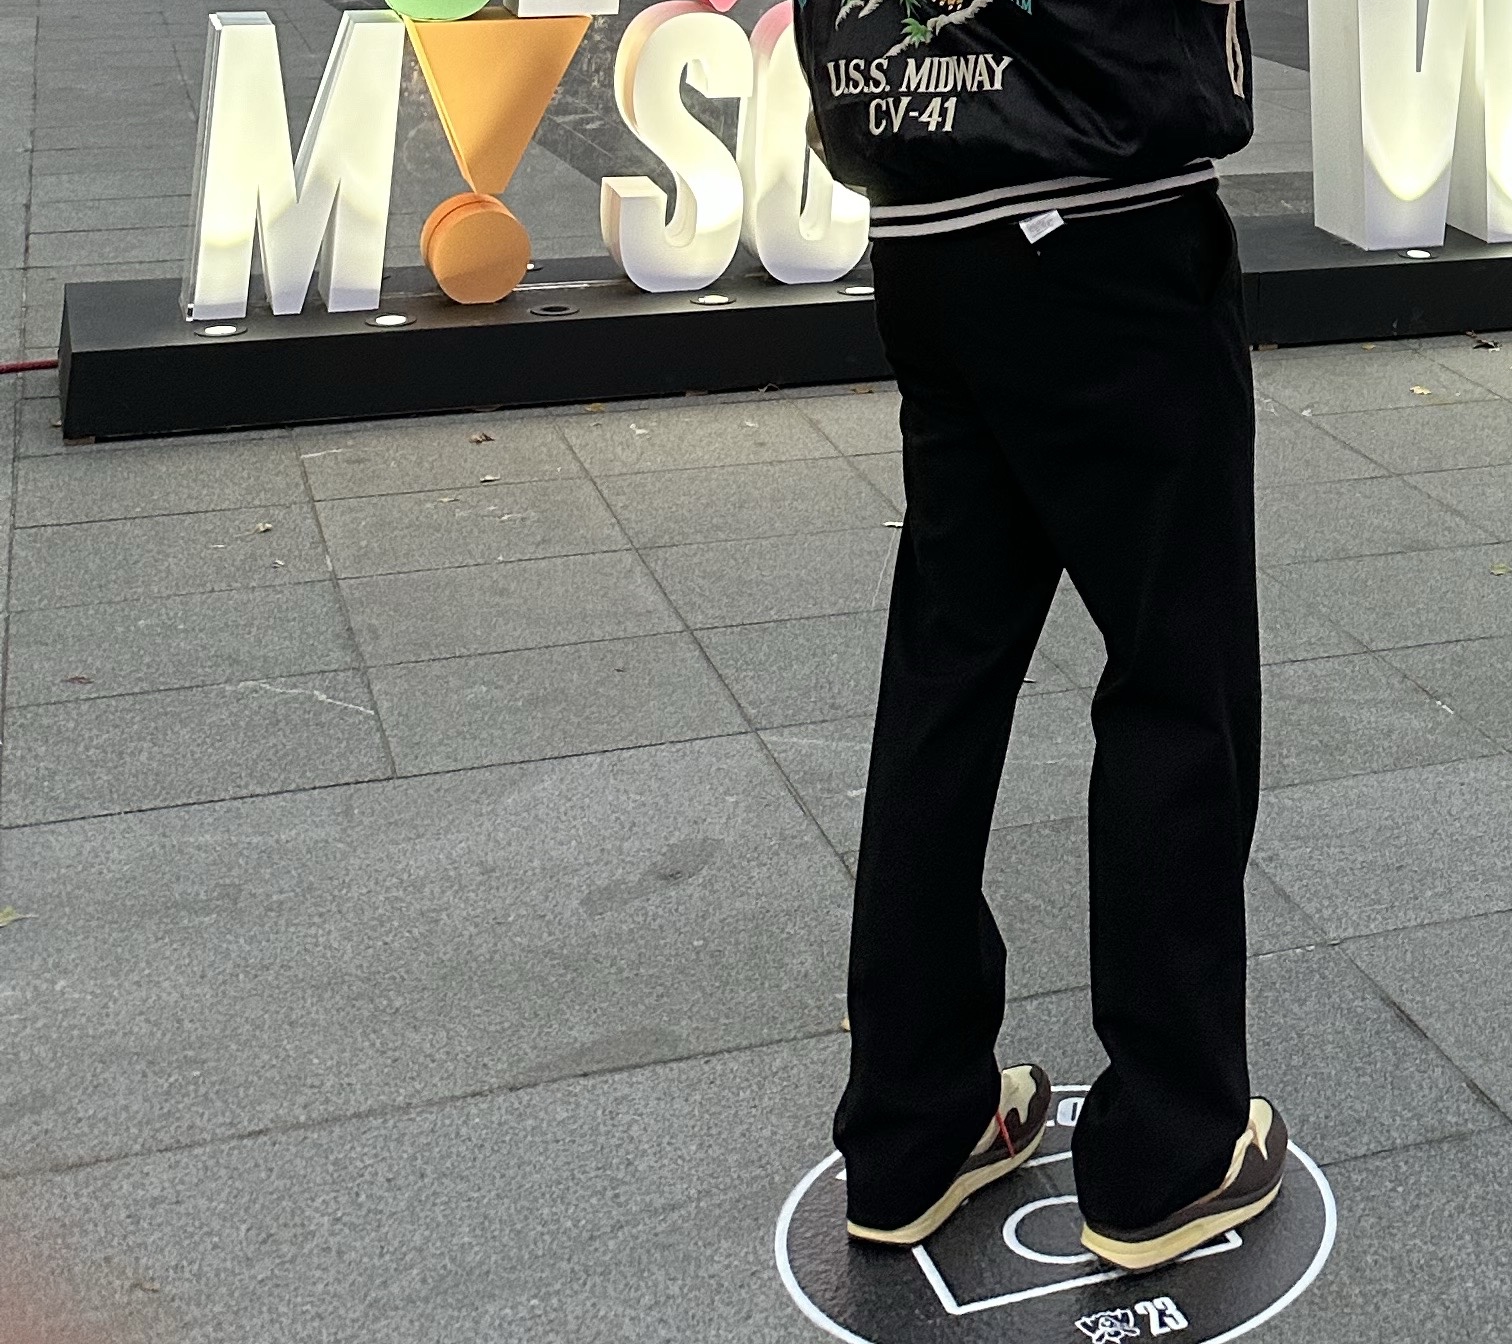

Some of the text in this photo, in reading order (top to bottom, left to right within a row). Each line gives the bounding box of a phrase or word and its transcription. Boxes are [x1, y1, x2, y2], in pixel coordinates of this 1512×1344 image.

[827, 52, 1014, 97] U.S.S. MIDWAY
[868, 95, 958, 137] CV-41
[1133, 1296, 1189, 1336] 23
